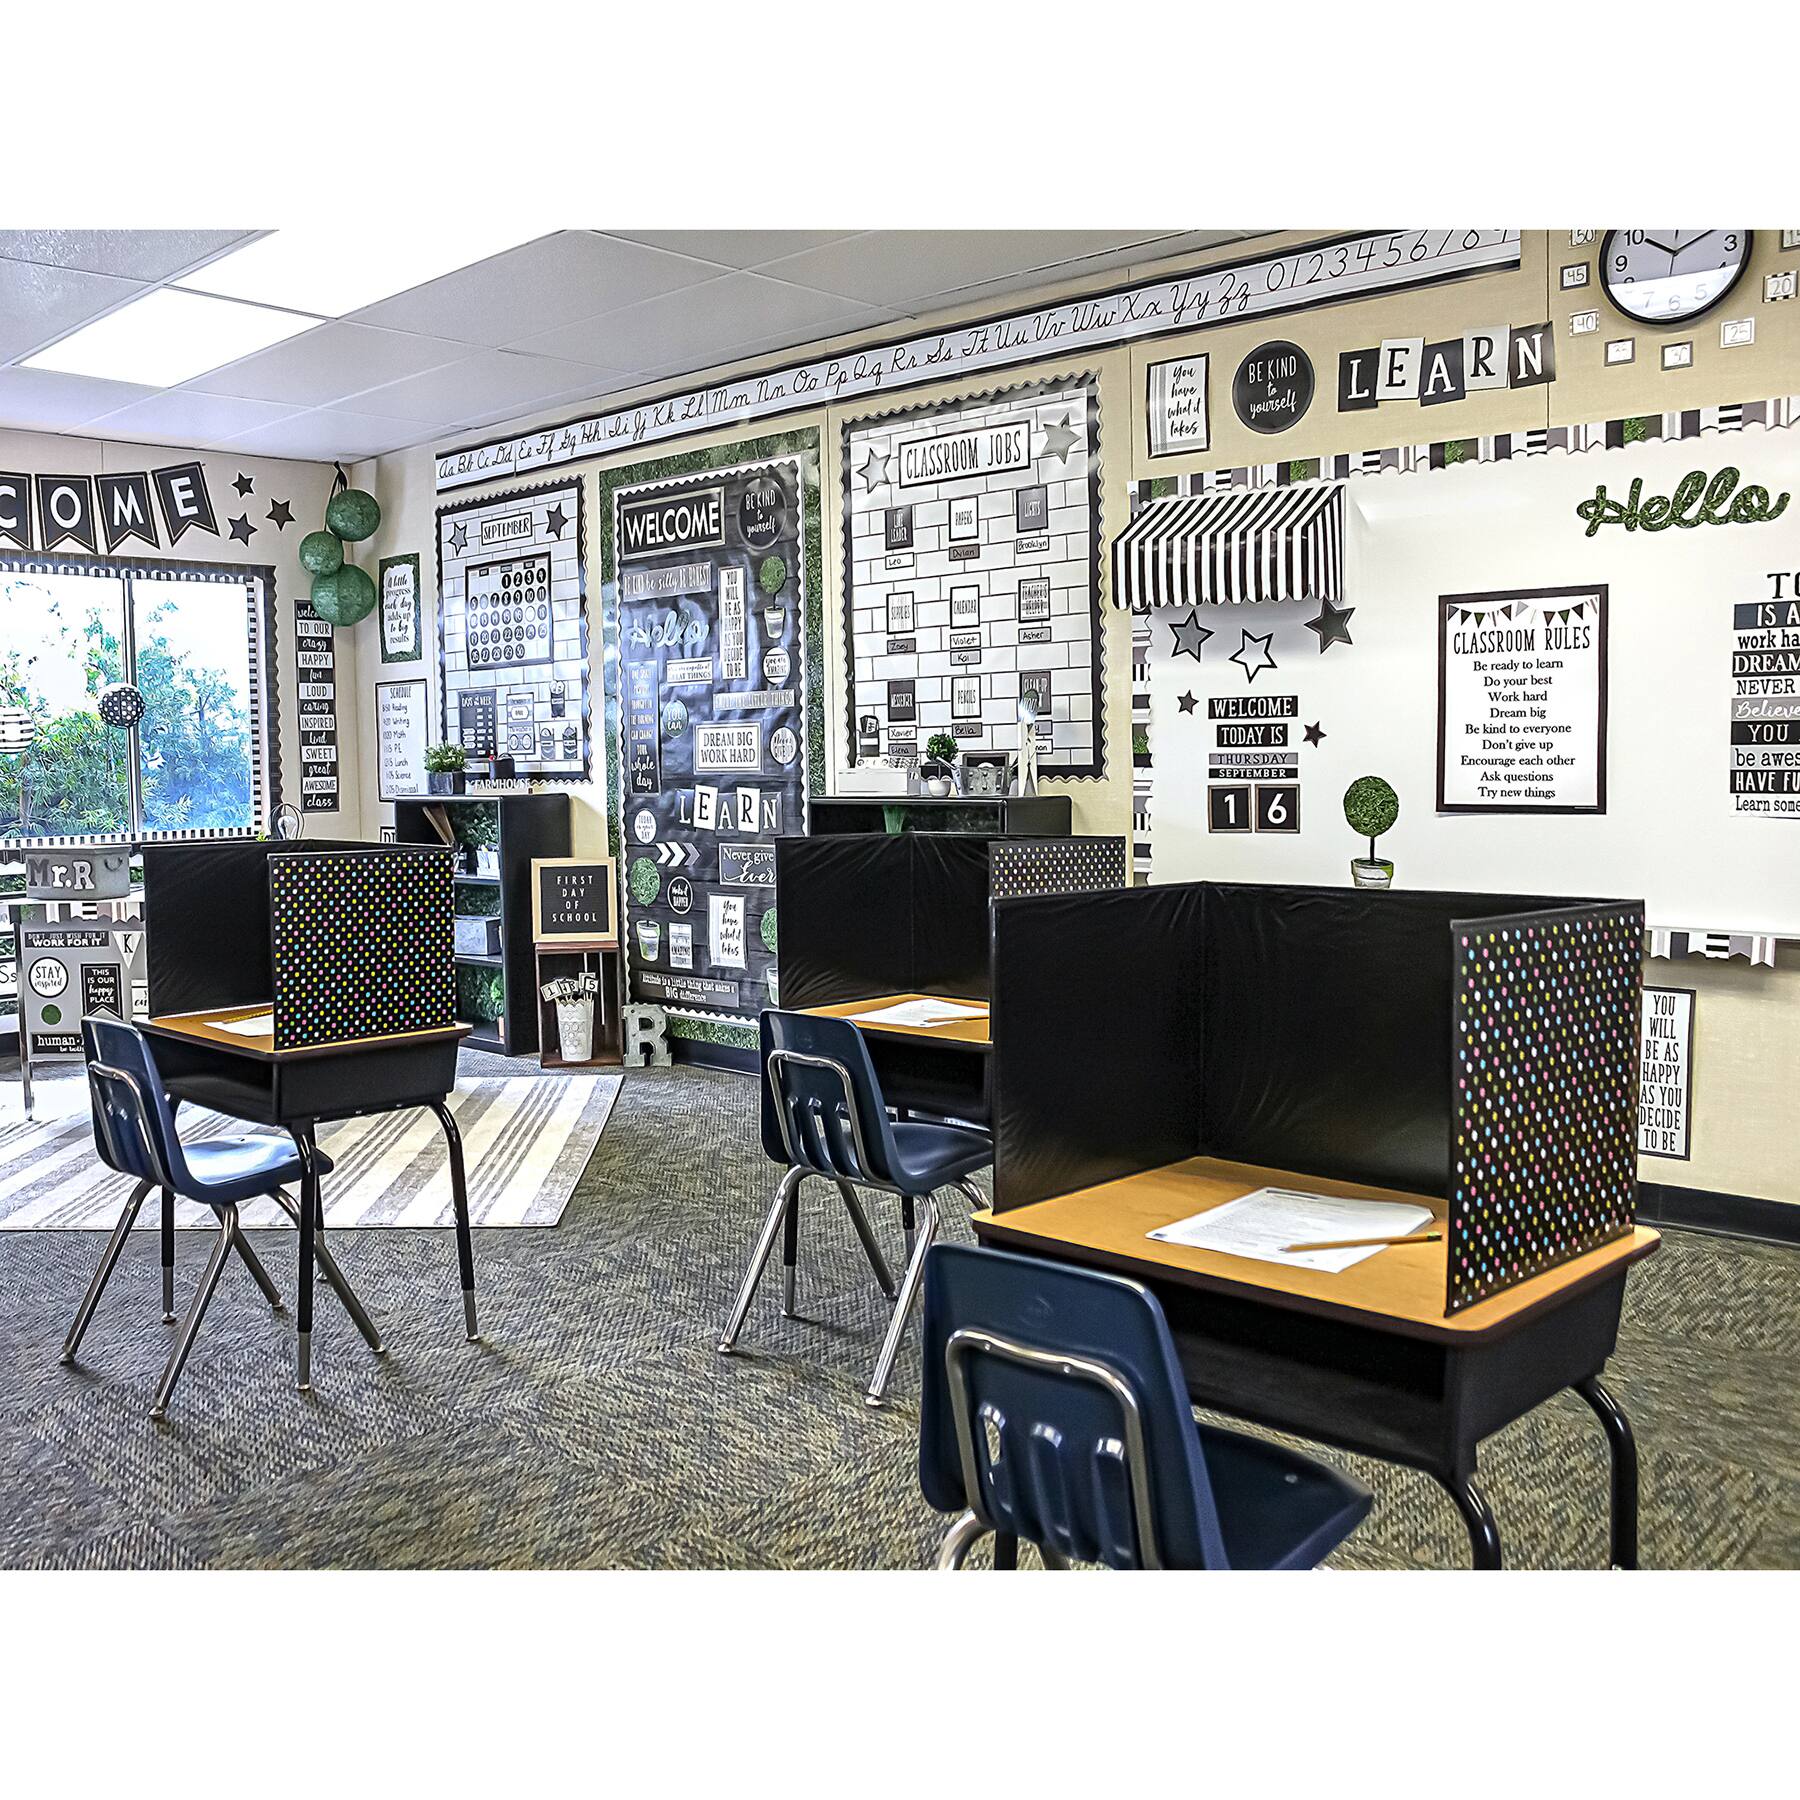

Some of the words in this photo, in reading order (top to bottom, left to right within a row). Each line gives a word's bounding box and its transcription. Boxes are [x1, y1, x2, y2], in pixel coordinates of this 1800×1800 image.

[1624, 230, 1645, 246] 10
[1724, 234, 1738, 251] 3
[1615, 255, 1628, 272] 9
[1567, 268, 1585, 282] 45
[1771, 278, 1792, 296] 20
[1668, 295, 1681, 311] 6
[1694, 284, 1707, 300] 5
[1577, 315, 1594, 331] 40
[653, 404, 675, 428] Kk
[712, 388, 750, 413] Mm
[757, 379, 785, 402] Nn
[793, 370, 819, 393] Oo
[826, 362, 848, 395] Pp
[891, 347, 917, 372] Rr
[994, 322, 1029, 348] Uu
[1033, 312, 1066, 340] Vv
[1071, 303, 1117, 332] Ww
[1121, 292, 1163, 323] Xx
[1170, 281, 1210, 324] Yy
[1219, 272, 1251, 315] Zz
[1248, 361, 1263, 384] BE
[1268, 355, 1297, 380] KIND
[1347, 332, 1543, 400] LEARN
[1171, 384, 1197, 398] have
[1267, 381, 1277, 397] to
[1250, 389, 1297, 420] yourself
[1171, 420, 1199, 437] takes
[906, 437, 980, 479] CLASSROOM
[987, 431, 1022, 467] JOBS
[745, 492, 755, 511] BE
[757, 489, 776, 508] KIND
[1576, 466, 1791, 538] Hello
[484, 518, 530, 540] SEPTEMBER
[626, 501, 719, 548] WELCOME
[746, 517, 776, 537] yourself
[1018, 538, 1047, 551] Brooklyn
[658, 572, 678, 592] silly
[1757, 604, 1777, 627] IS
[299, 623, 309, 634] TO
[314, 622, 330, 635] OUR
[1023, 631, 1044, 640] Asher
[302, 638, 327, 651] crazy
[953, 636, 977, 646] Violet
[1453, 628, 1536, 655] CLASSROOM
[1544, 625, 1591, 650] RULES
[1737, 629, 1777, 649] work
[302, 654, 329, 665] HAPPY
[1473, 661, 1488, 671] Be
[1490, 660, 1520, 672] ready
[1522, 661, 1533, 670] to
[1535, 658, 1564, 670] learn
[1484, 677, 1500, 687] Do
[1503, 677, 1527, 688] your
[1530, 675, 1553, 686] best
[1736, 678, 1795, 696] NEVER
[307, 686, 327, 697] LOUD
[1488, 691, 1520, 702] Work
[1523, 691, 1548, 702] hard
[303, 702, 329, 714] caring
[1213, 697, 1293, 718] WELCOME
[1490, 707, 1527, 718] Dream
[1530, 707, 1547, 720] big
[301, 717, 334, 729] INSPIRED
[954, 726, 977, 735] Bella
[1465, 724, 1480, 735] Be
[1482, 723, 1507, 734] kind
[1509, 724, 1520, 734] to
[1523, 725, 1572, 736] everyone
[703, 732, 734, 747] DREAM
[737, 731, 753, 746] BIG
[1221, 726, 1265, 745] TODAY
[1271, 725, 1283, 744] IS
[1747, 724, 1789, 742] YOU
[1482, 739, 1513, 750] Don't
[1515, 740, 1536, 752] give
[1539, 741, 1554, 751] up
[306, 748, 332, 760] SWEET
[701, 749, 728, 763] WORK
[730, 748, 756, 763] HARD
[1218, 753, 1288, 765] THURSDAY
[1461, 755, 1516, 768] Encourage
[1518, 755, 1543, 766] each
[1546, 755, 1576, 766] other
[1734, 748, 1756, 766] be
[308, 761, 331, 776] great
[631, 756, 655, 772] whole
[1219, 768, 1287, 778] SEPTEMBER
[1480, 771, 1501, 782] Ask
[1503, 771, 1554, 784] questions
[304, 779, 336, 791] AWESOME
[636, 773, 652, 790] day
[1735, 771, 1776, 792] HAVE
[307, 794, 333, 807] class
[1477, 786, 1498, 799] Try
[1500, 788, 1522, 798] new
[1524, 787, 1556, 799] things
[679, 792, 778, 830] LEARN
[1735, 795, 1771, 811] Learn
[723, 848, 753, 863] Never
[754, 850, 774, 865] give
[557, 875, 593, 885] FIRST
[724, 860, 776, 884] Ever
[562, 888, 585, 898] DAY
[565, 901, 580, 910] OF
[552, 912, 597, 922] SCHOOL
[32, 939, 65, 947] WORK
[68, 939, 90, 947] FOR
[90, 938, 102, 946] IT
[123, 933, 133, 953] K
[36, 966, 61, 979] STAY
[34, 978, 63, 990] inspired
[589, 980, 596, 990] 5
[665, 986, 678, 999] BIG
[1653, 994, 1676, 1016] YOU
[621, 1002, 672, 1067] R
[1650, 1017, 1676, 1040] WILL
[1645, 1039, 1659, 1061] BE
[1664, 1042, 1679, 1063] AS
[1643, 1062, 1680, 1085] HAPPY
[1640, 1085, 1655, 1104] AS
[1659, 1086, 1682, 1108] YOU
[1640, 1106, 1681, 1130] DECIDE
[1644, 1128, 1657, 1149] TO
[1662, 1130, 1676, 1152] BE
